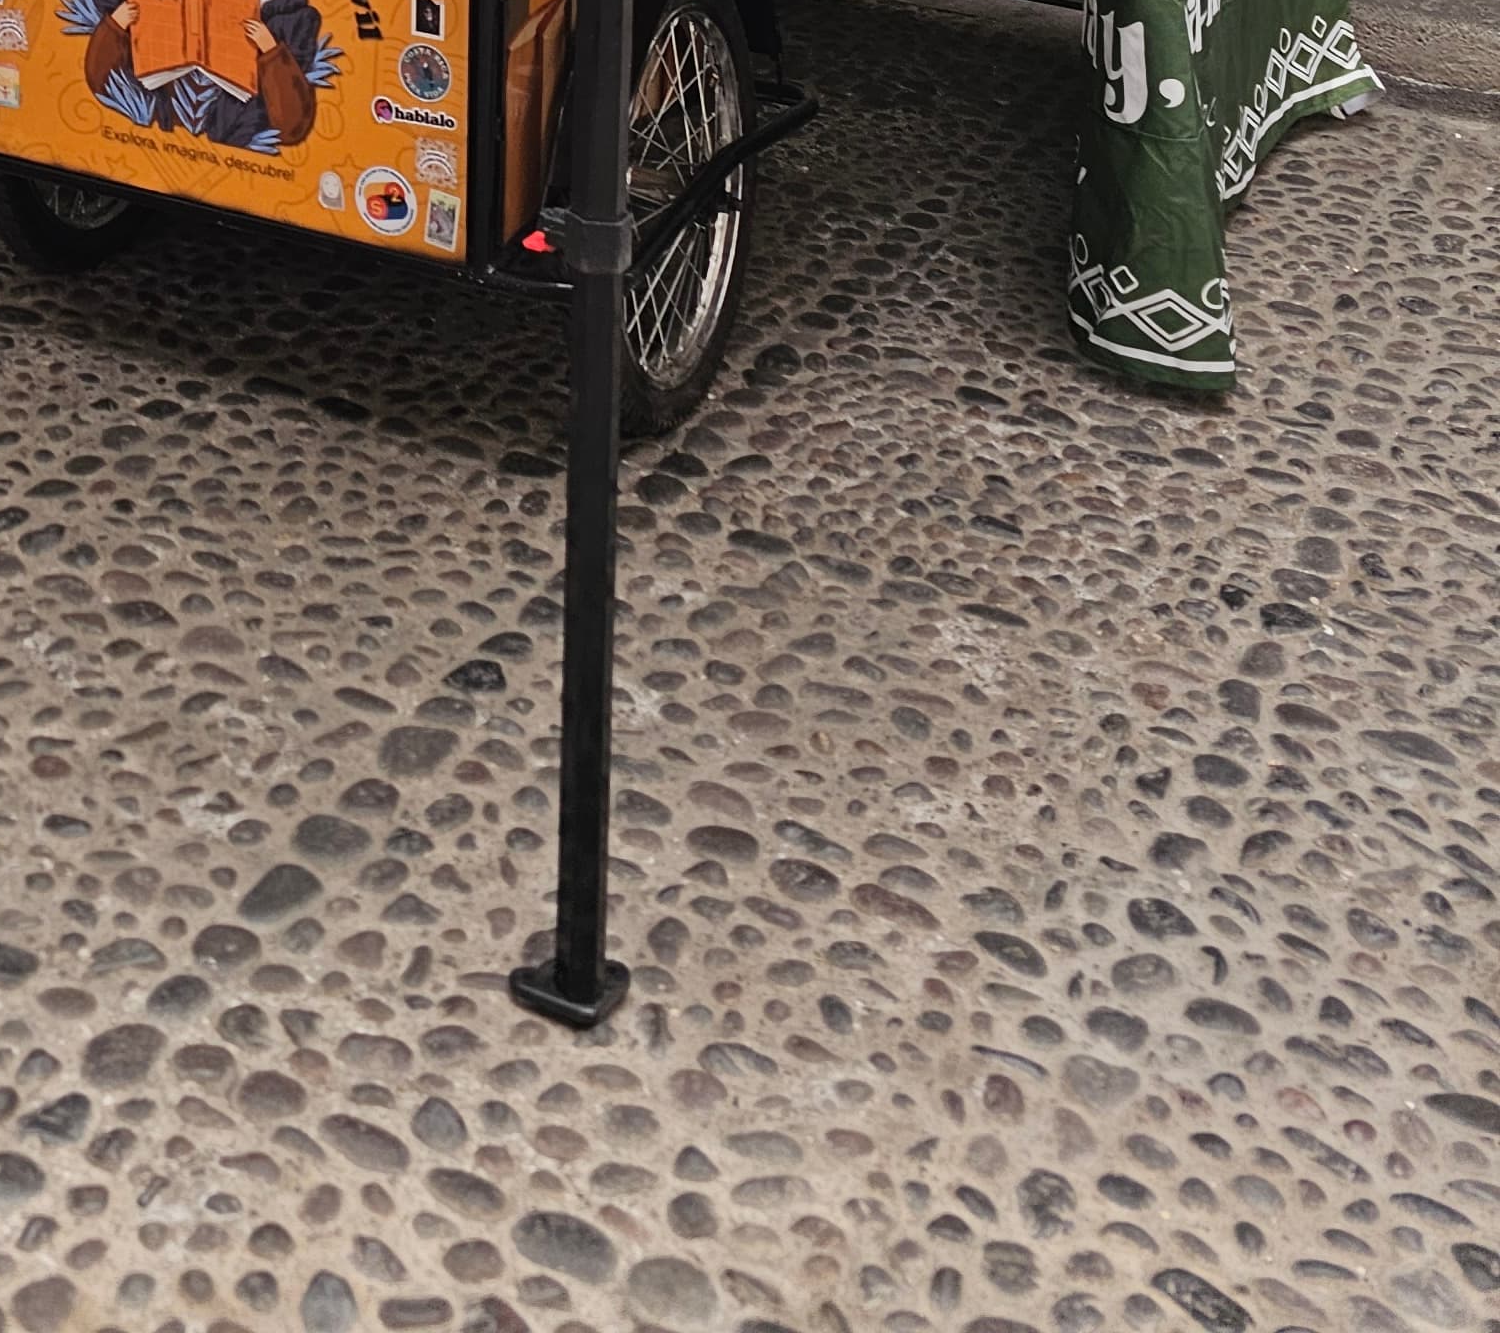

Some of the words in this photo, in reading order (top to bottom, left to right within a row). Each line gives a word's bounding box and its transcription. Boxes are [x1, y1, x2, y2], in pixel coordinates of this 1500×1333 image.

[394, 106, 456, 129] hablalo
[102, 125, 159, 152] Explora,
[162, 141, 220, 166] imagina,
[224, 155, 295, 182] descubre!
